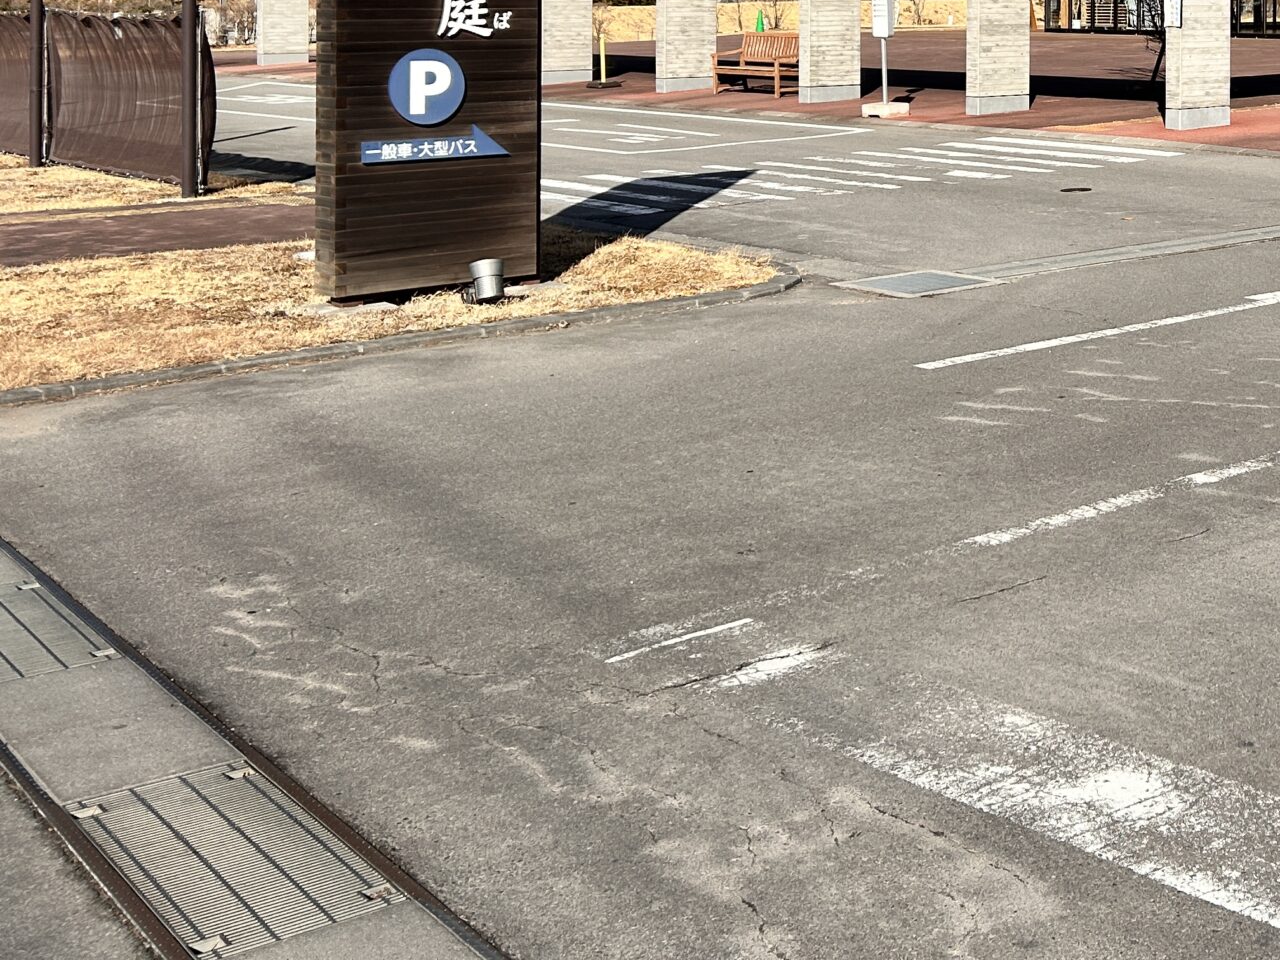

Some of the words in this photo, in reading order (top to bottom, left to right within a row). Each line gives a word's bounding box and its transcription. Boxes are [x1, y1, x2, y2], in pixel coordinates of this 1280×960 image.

[409, 60, 452, 115] P
[365, 140, 478, 160] 一般車・大型バス
